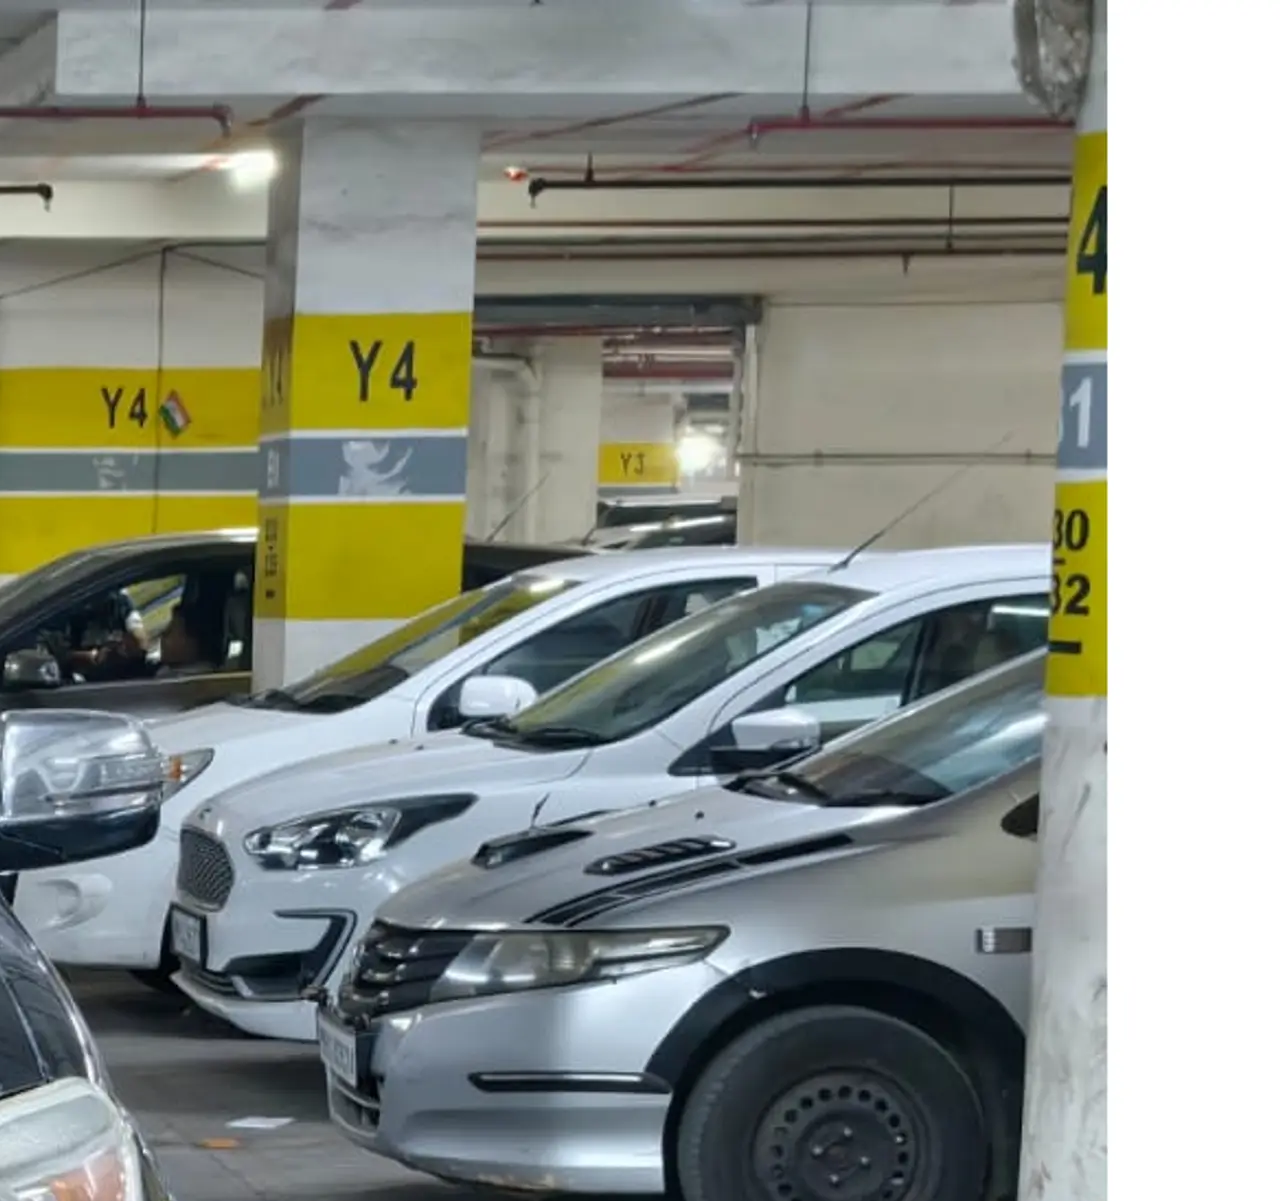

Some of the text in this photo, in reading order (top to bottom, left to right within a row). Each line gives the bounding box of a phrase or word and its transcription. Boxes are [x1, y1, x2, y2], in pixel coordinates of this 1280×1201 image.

[1076, 185, 1107, 294] 4
[349, 340, 418, 402] Y4
[101, 387, 148, 428] Y4
